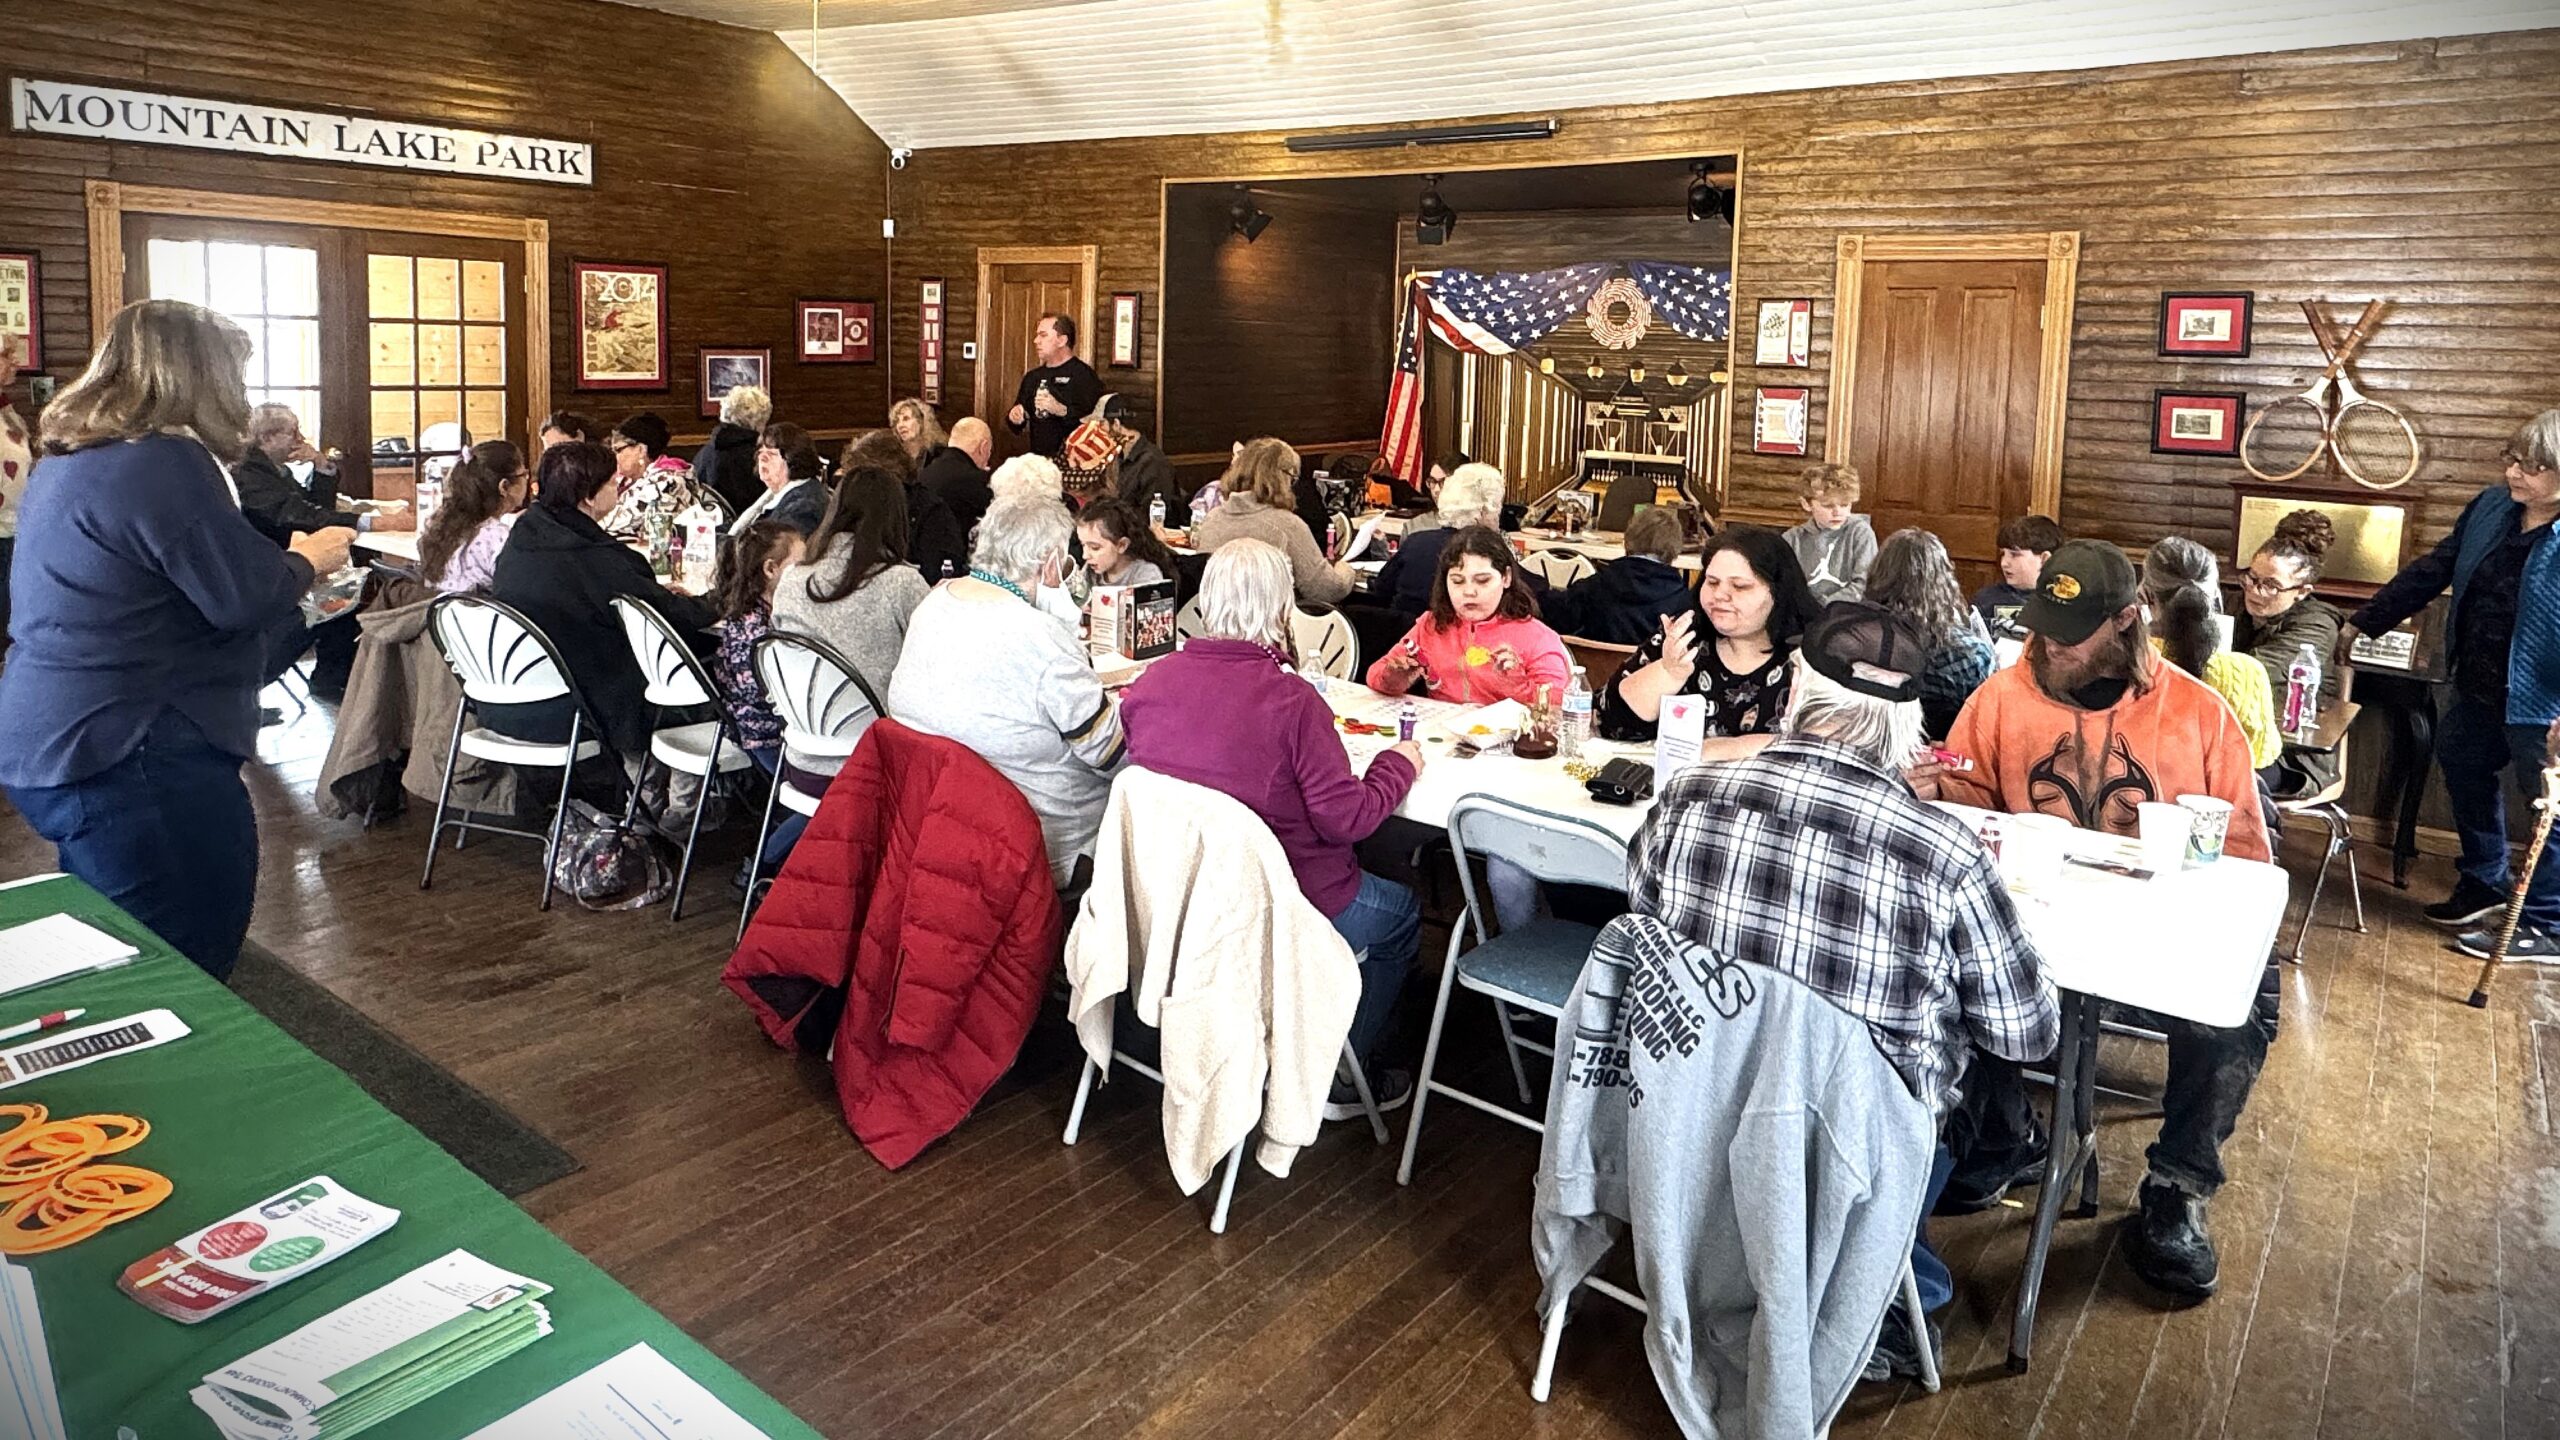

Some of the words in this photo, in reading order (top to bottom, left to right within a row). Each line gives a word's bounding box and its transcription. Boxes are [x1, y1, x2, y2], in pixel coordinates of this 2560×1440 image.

[25, 88, 310, 147] MOUNTAIN
[334, 124, 457, 163] LAKE
[476, 141, 585, 176] PARK
[1638, 916, 1675, 963] HOME
[1667, 928, 1756, 1020] ES
[1675, 994, 1706, 1030] LLC
